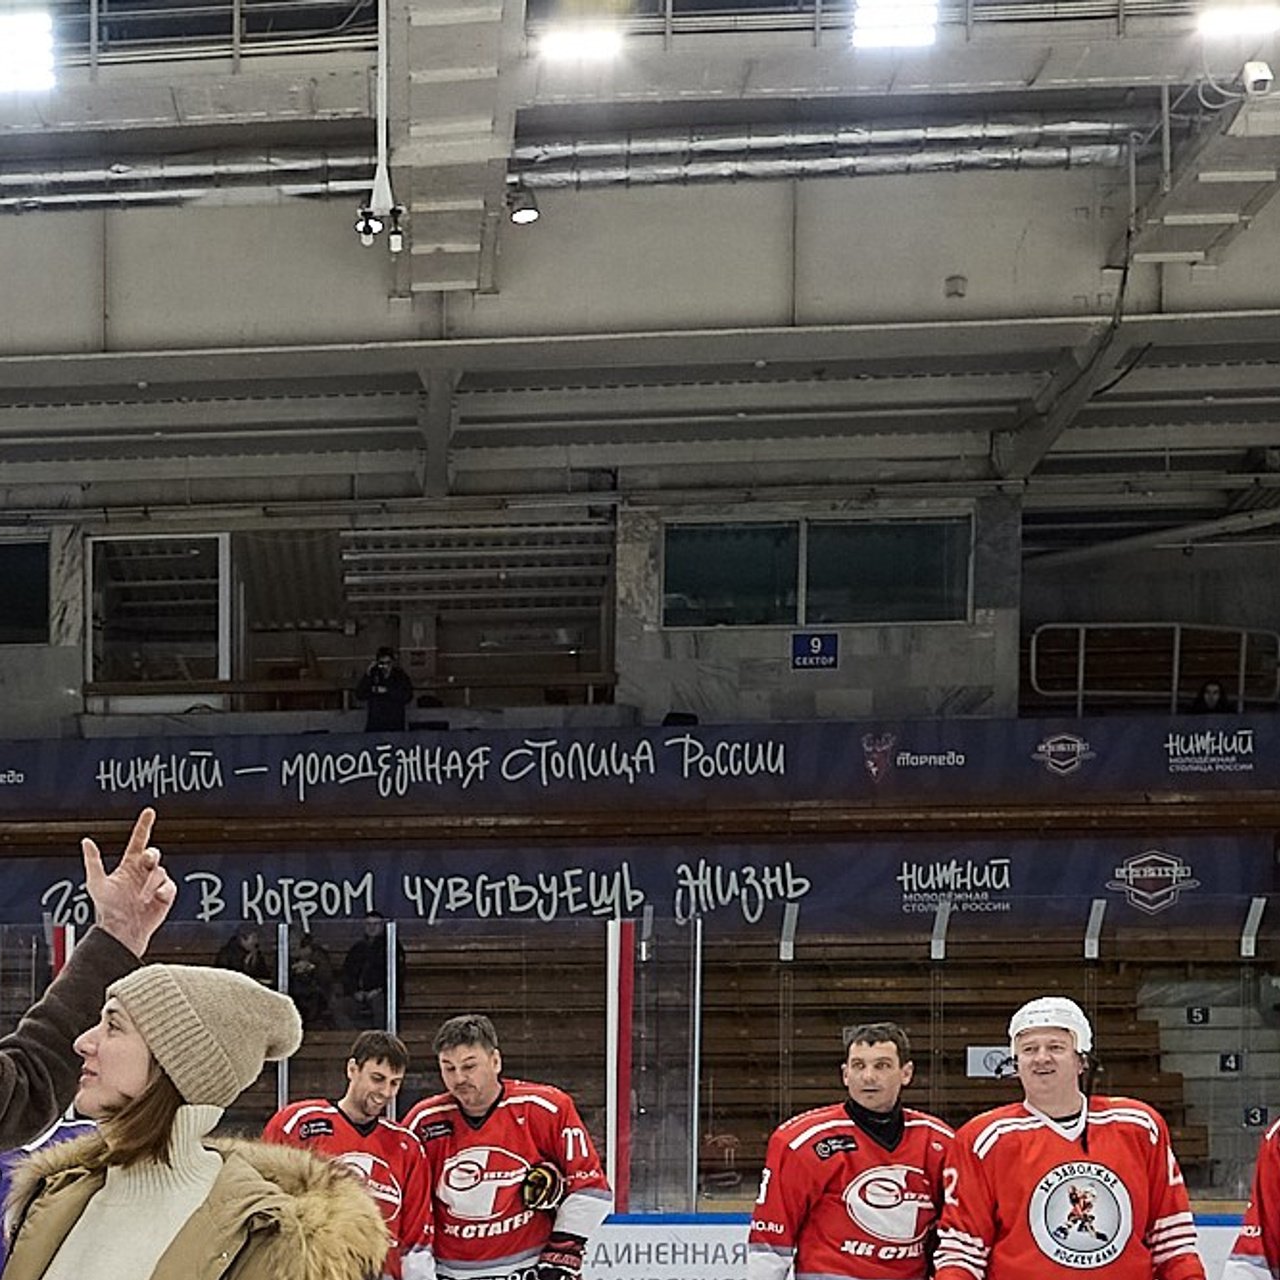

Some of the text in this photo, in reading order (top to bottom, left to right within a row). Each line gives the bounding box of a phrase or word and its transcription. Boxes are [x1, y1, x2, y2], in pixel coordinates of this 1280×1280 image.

[810, 636, 822, 654] 9
[794, 656, 835, 666] СЕКТОР
[1163, 730, 1254, 756] НИЖНИЙ
[96, 749, 223, 797] НИЖНИЙ
[501, 739, 655, 785] СТОЛИЦА
[896, 858, 1011, 891] НИЖНИЙ
[185, 871, 224, 922] В
[675, 859, 811, 925] ЖИЗНЬ
[961, 901, 1011, 912] РОССИИ
[1191, 1007, 1203, 1023] 5
[1225, 1054, 1236, 1070] 4
[1249, 1107, 1261, 1125] 3
